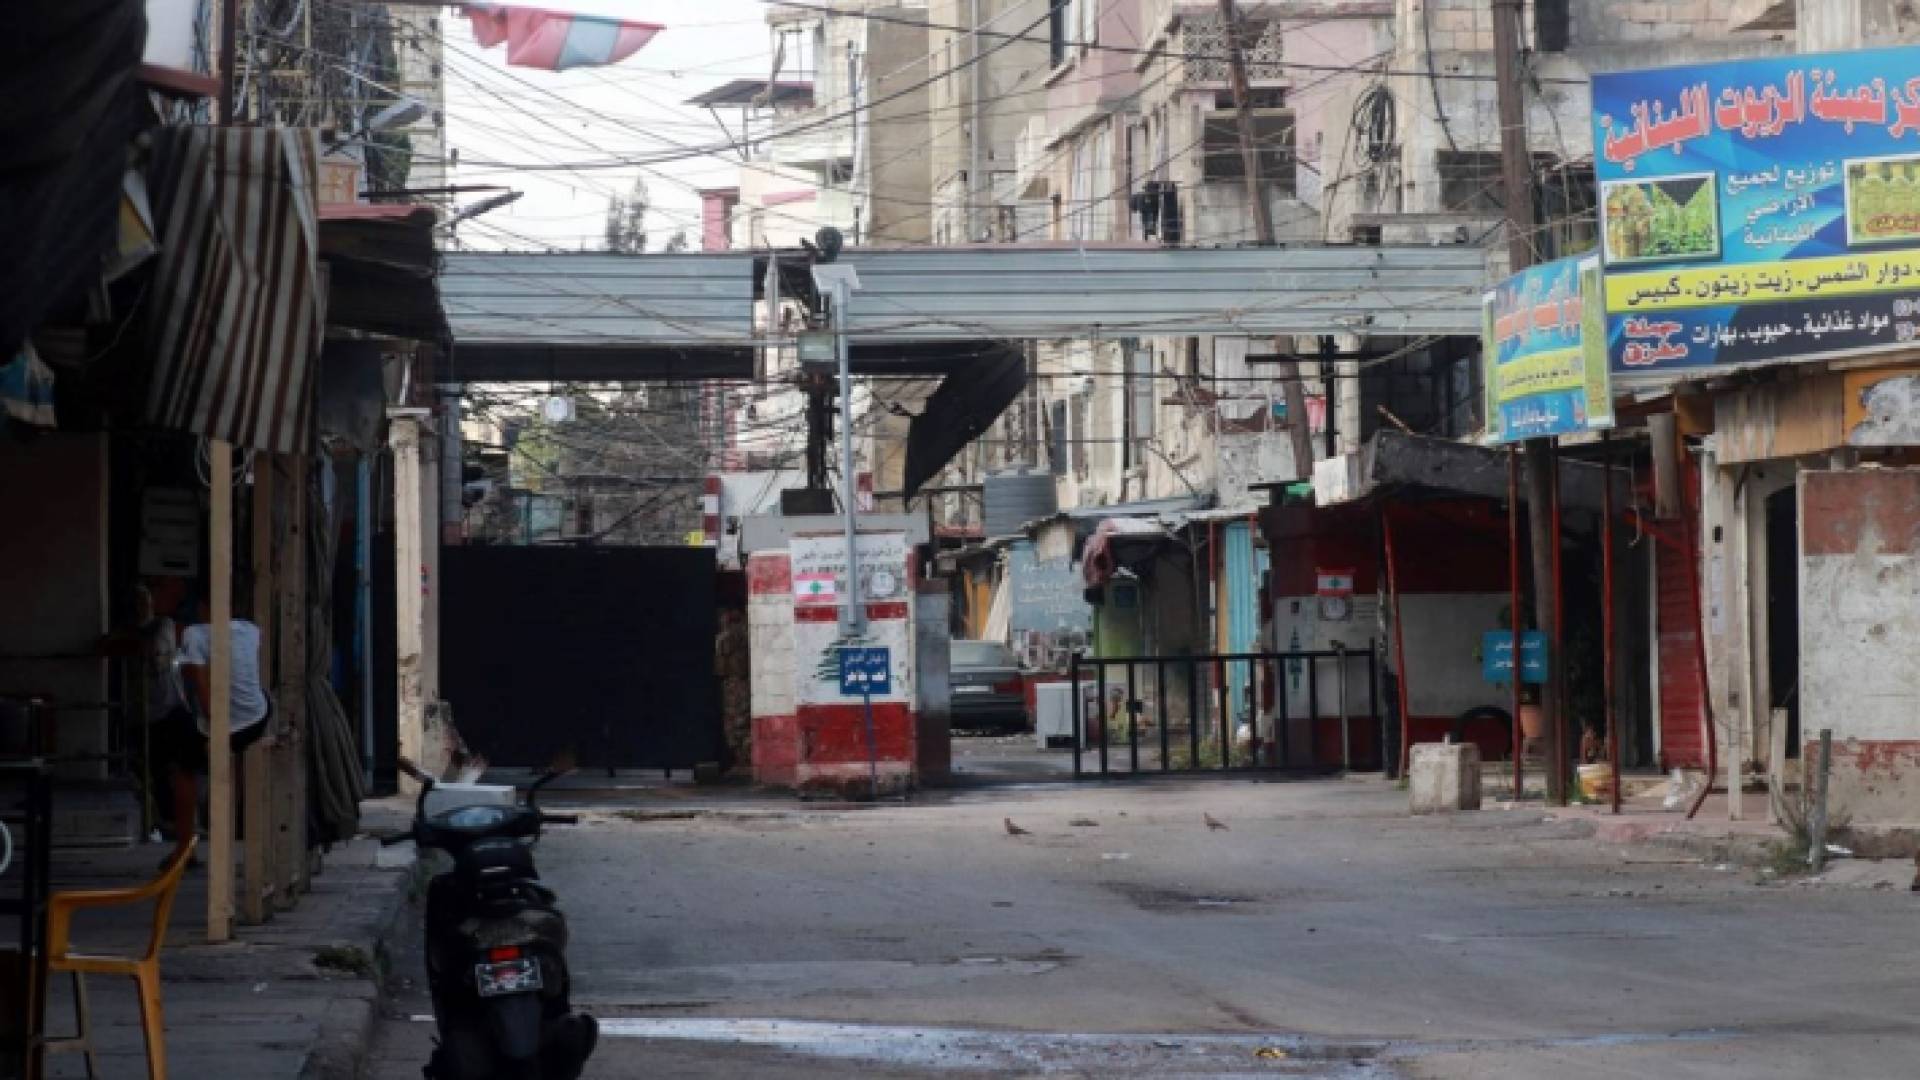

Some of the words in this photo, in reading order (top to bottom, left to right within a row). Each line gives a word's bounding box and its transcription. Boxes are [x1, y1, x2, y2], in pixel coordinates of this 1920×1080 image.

[1715, 69, 1804, 138] الزيوت
[1600, 81, 1710, 171] اللبنانية
[1726, 164, 1779, 195] لجميع
[1785, 161, 1834, 190] توزيع
[1695, 273, 1749, 299] زيتون
[1755, 270, 1793, 292] زيت
[1806, 261, 1869, 291] الشمس
[1875, 262, 1911, 284] دوار
[1627, 275, 1681, 306] كبيس
[1691, 321, 1737, 349] بهارات
[1747, 323, 1792, 345] حبوب
[1858, 310, 1889, 336] مواد
